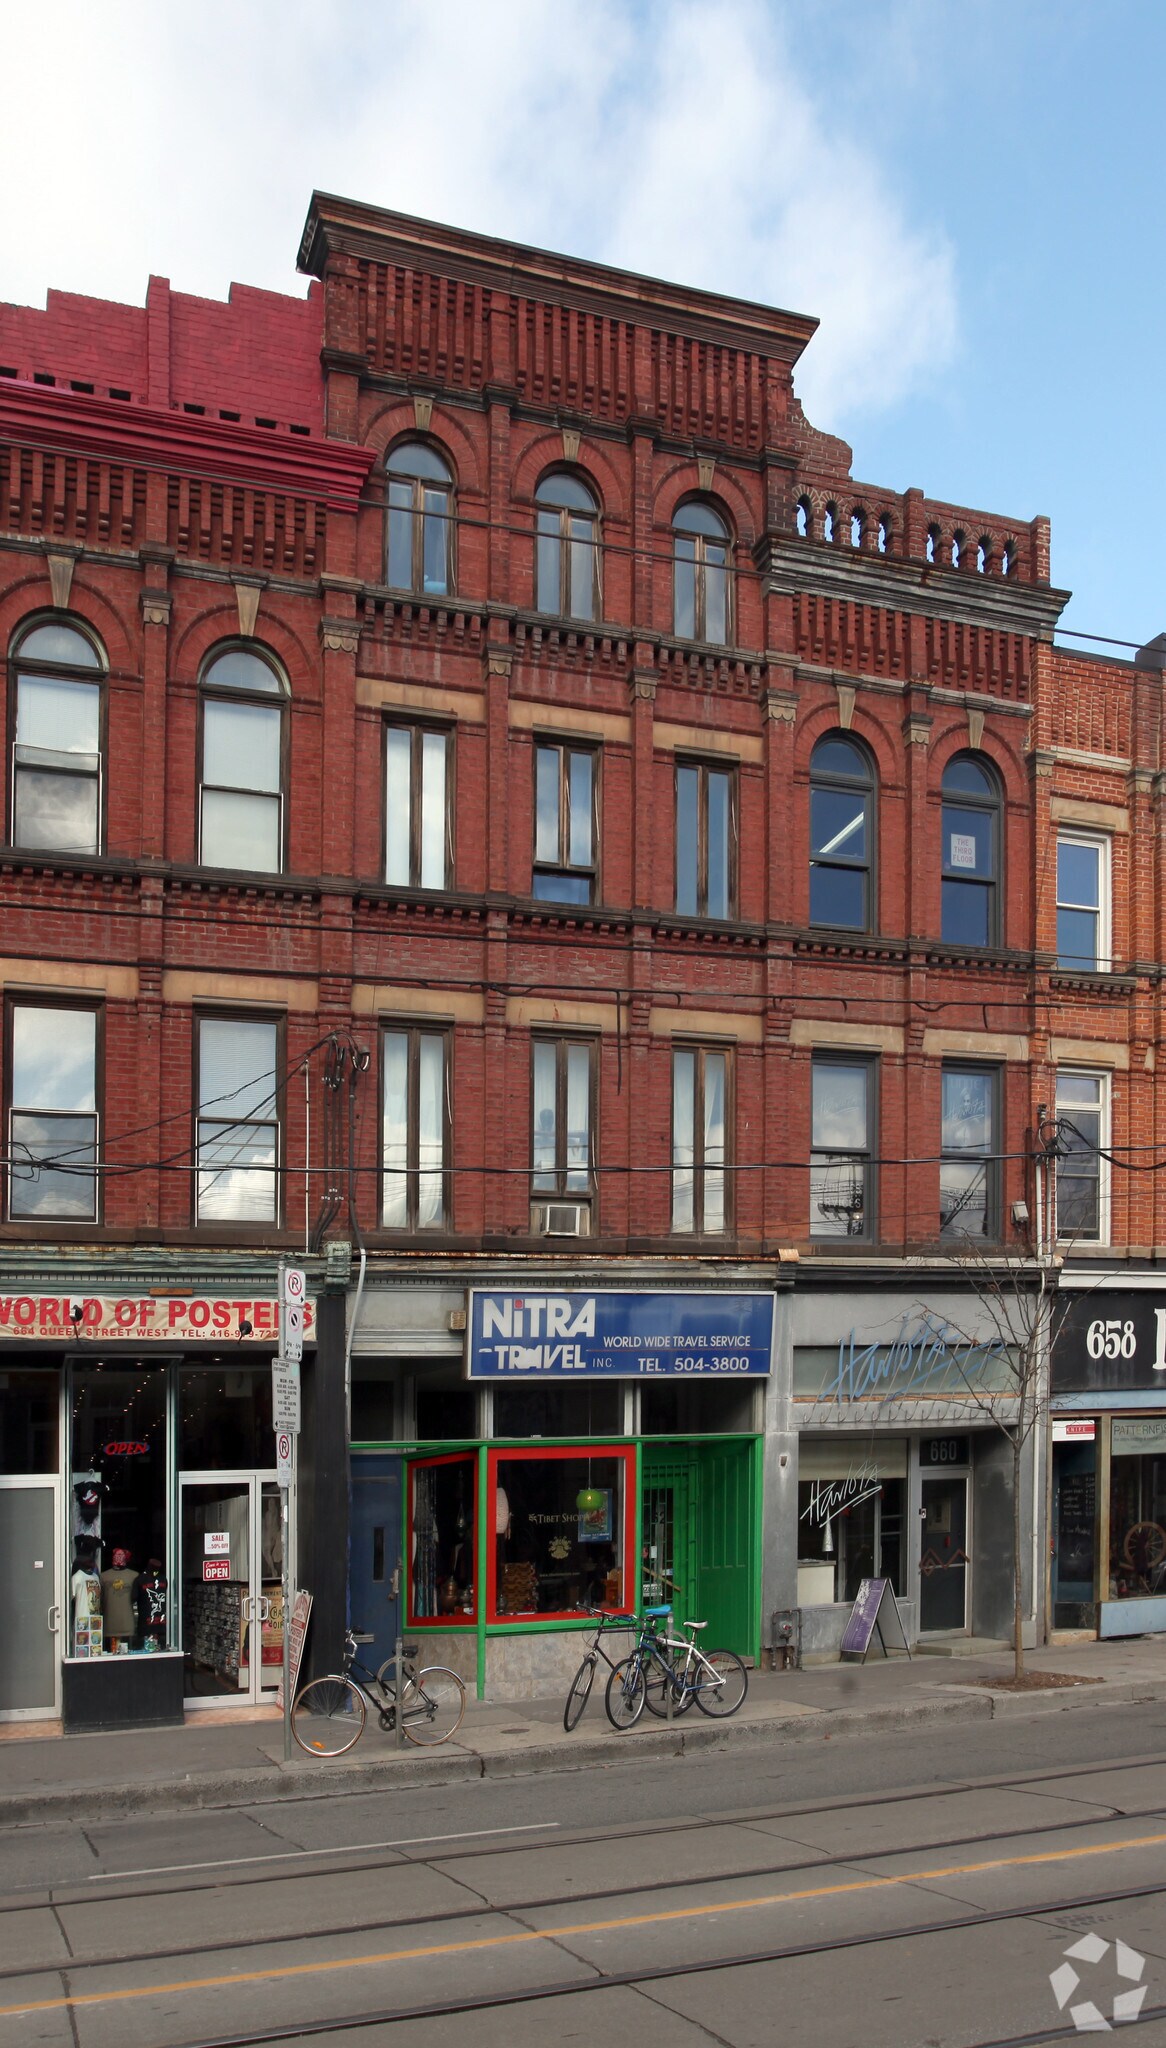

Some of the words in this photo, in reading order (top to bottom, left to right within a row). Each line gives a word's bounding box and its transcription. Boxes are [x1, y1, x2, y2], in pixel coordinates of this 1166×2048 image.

[953, 854, 974, 864] FLOOR
[947, 1199, 979, 1210] ROOM
[115, 1299, 157, 1328] OF
[13, 1327, 35, 1336] 664
[86, 1327, 132, 1337] STREET
[137, 1328, 169, 1337] WEST
[180, 1329, 206, 1338] TEL:
[603, 1335, 642, 1348] WORLD
[644, 1335, 671, 1348] WIDE
[673, 1335, 708, 1347] TRAVEL
[710, 1335, 751, 1347] SERVICE
[1086, 1320, 1137, 1359] 658
[592, 1357, 616, 1368] INC.
[638, 1358, 666, 1372] TEL.
[673, 1357, 750, 1372] 504-3800
[105, 1441, 148, 1455] OPEN
[930, 1440, 957, 1461] 660
[537, 1513, 560, 1524] TIBET
[211, 1534, 225, 1542] SALE
[205, 1567, 229, 1579] OPEN
